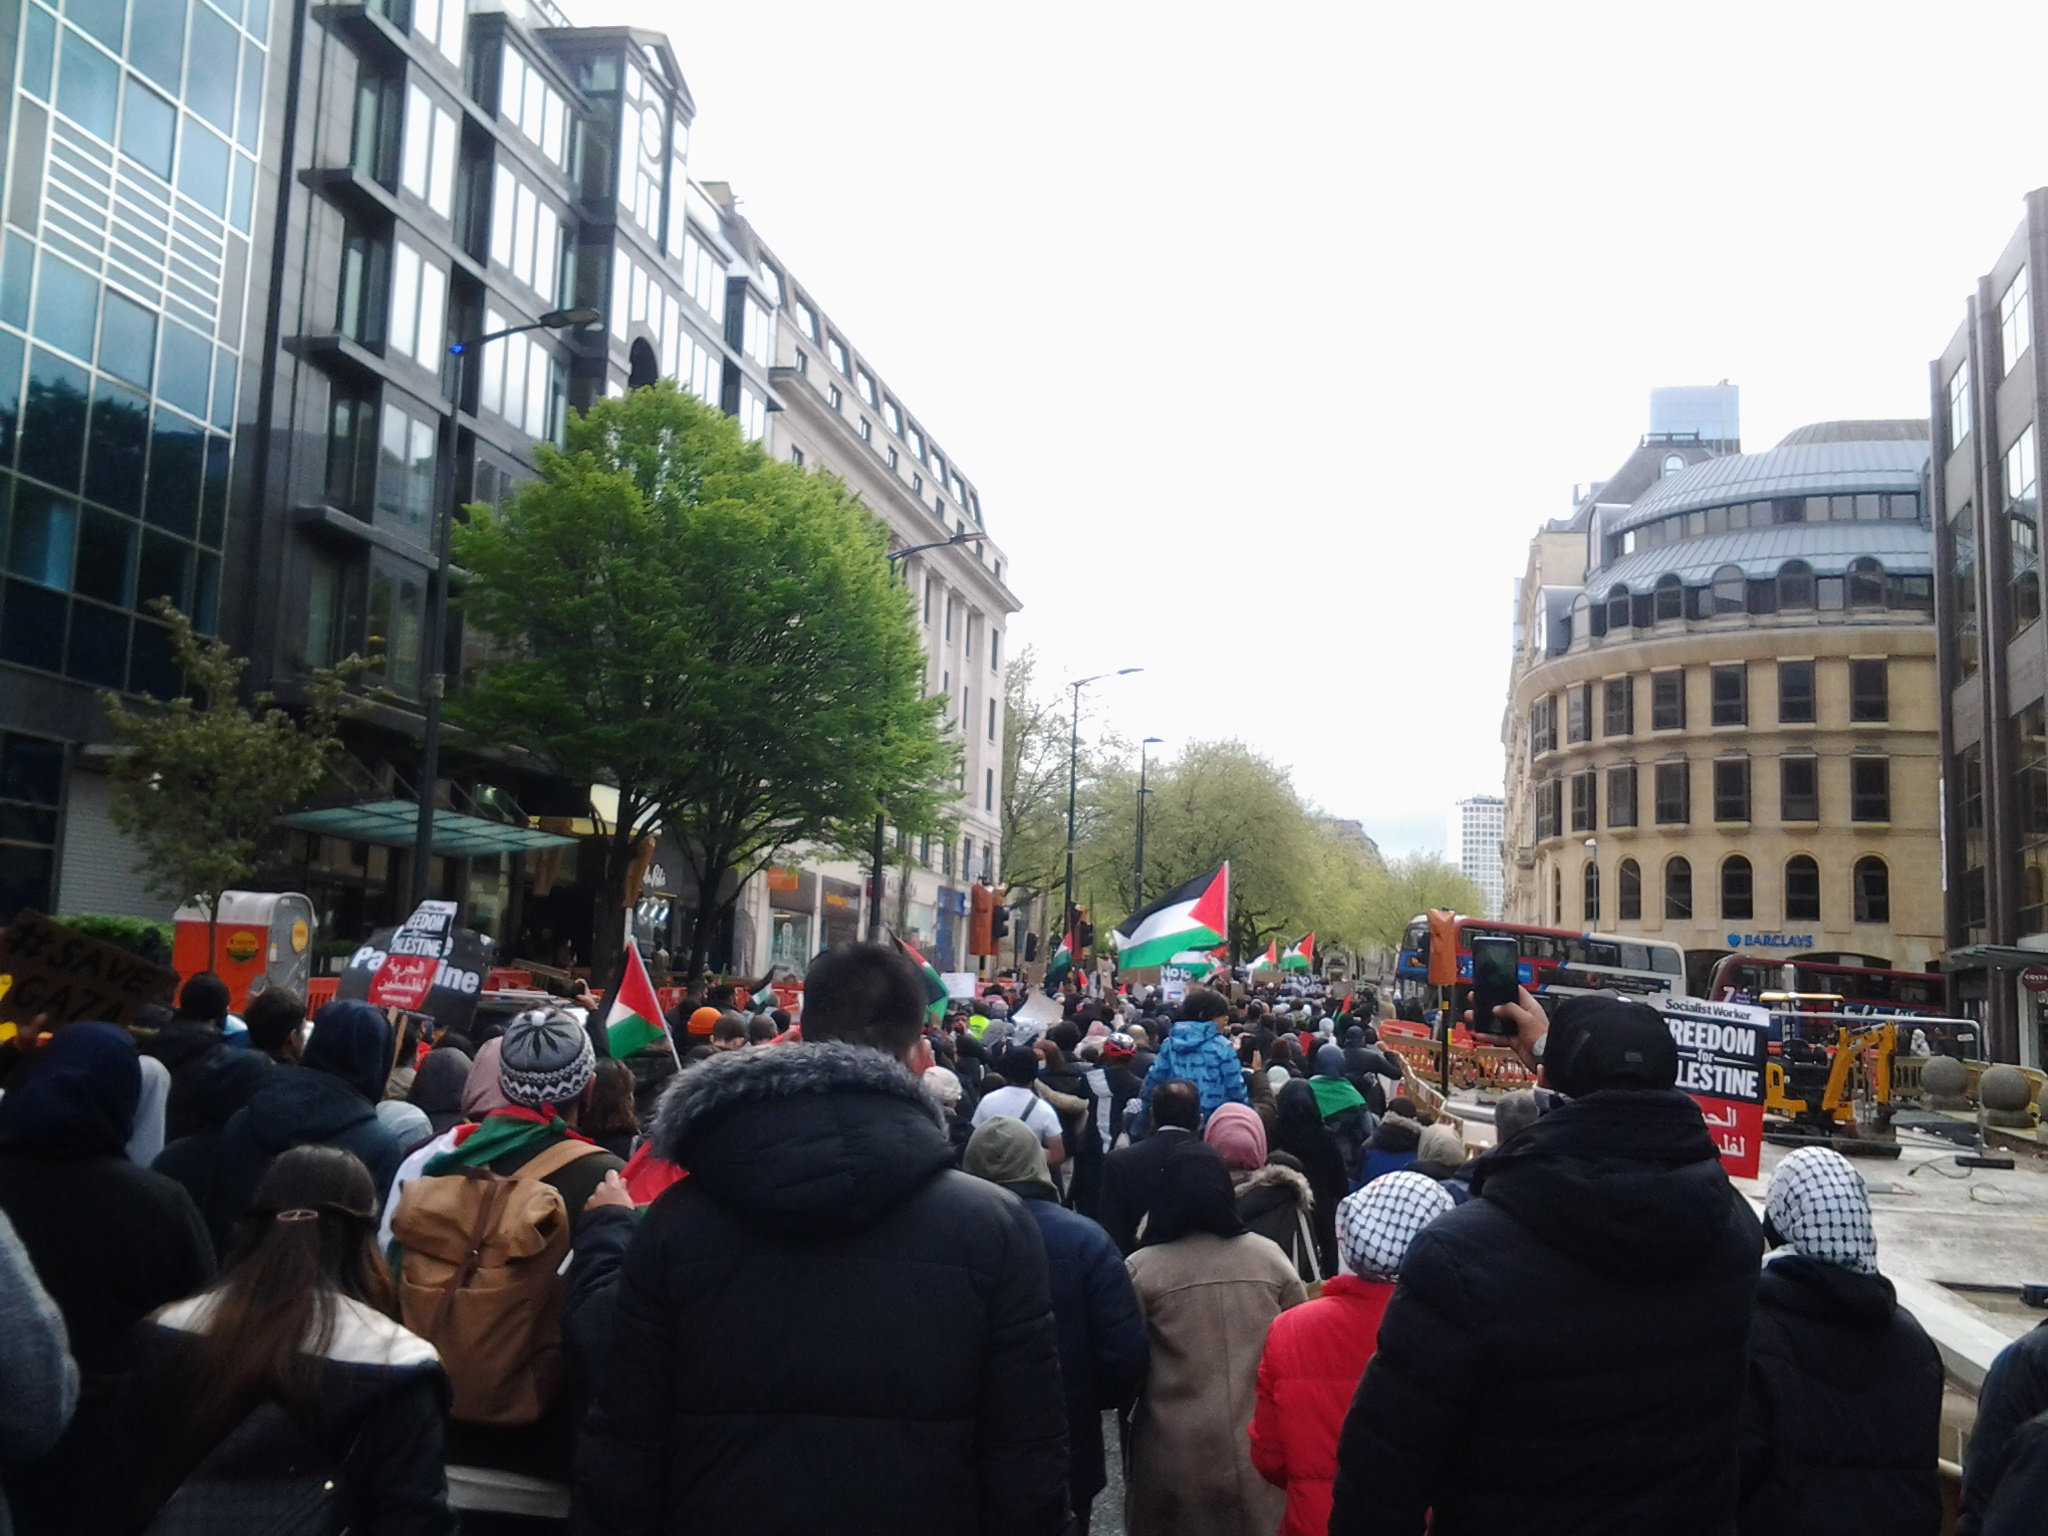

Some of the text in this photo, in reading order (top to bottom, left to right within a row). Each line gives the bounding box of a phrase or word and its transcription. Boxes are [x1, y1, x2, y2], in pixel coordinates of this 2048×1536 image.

[406, 912, 447, 932] EEDOM
[1744, 933, 1813, 948] BARCLAYS
[350, 946, 480, 994] Paine
[1665, 998, 1752, 1021] Socialist Worker
[1696, 1048, 1715, 1063] for
[1674, 1060, 1759, 1099] LESTINE
